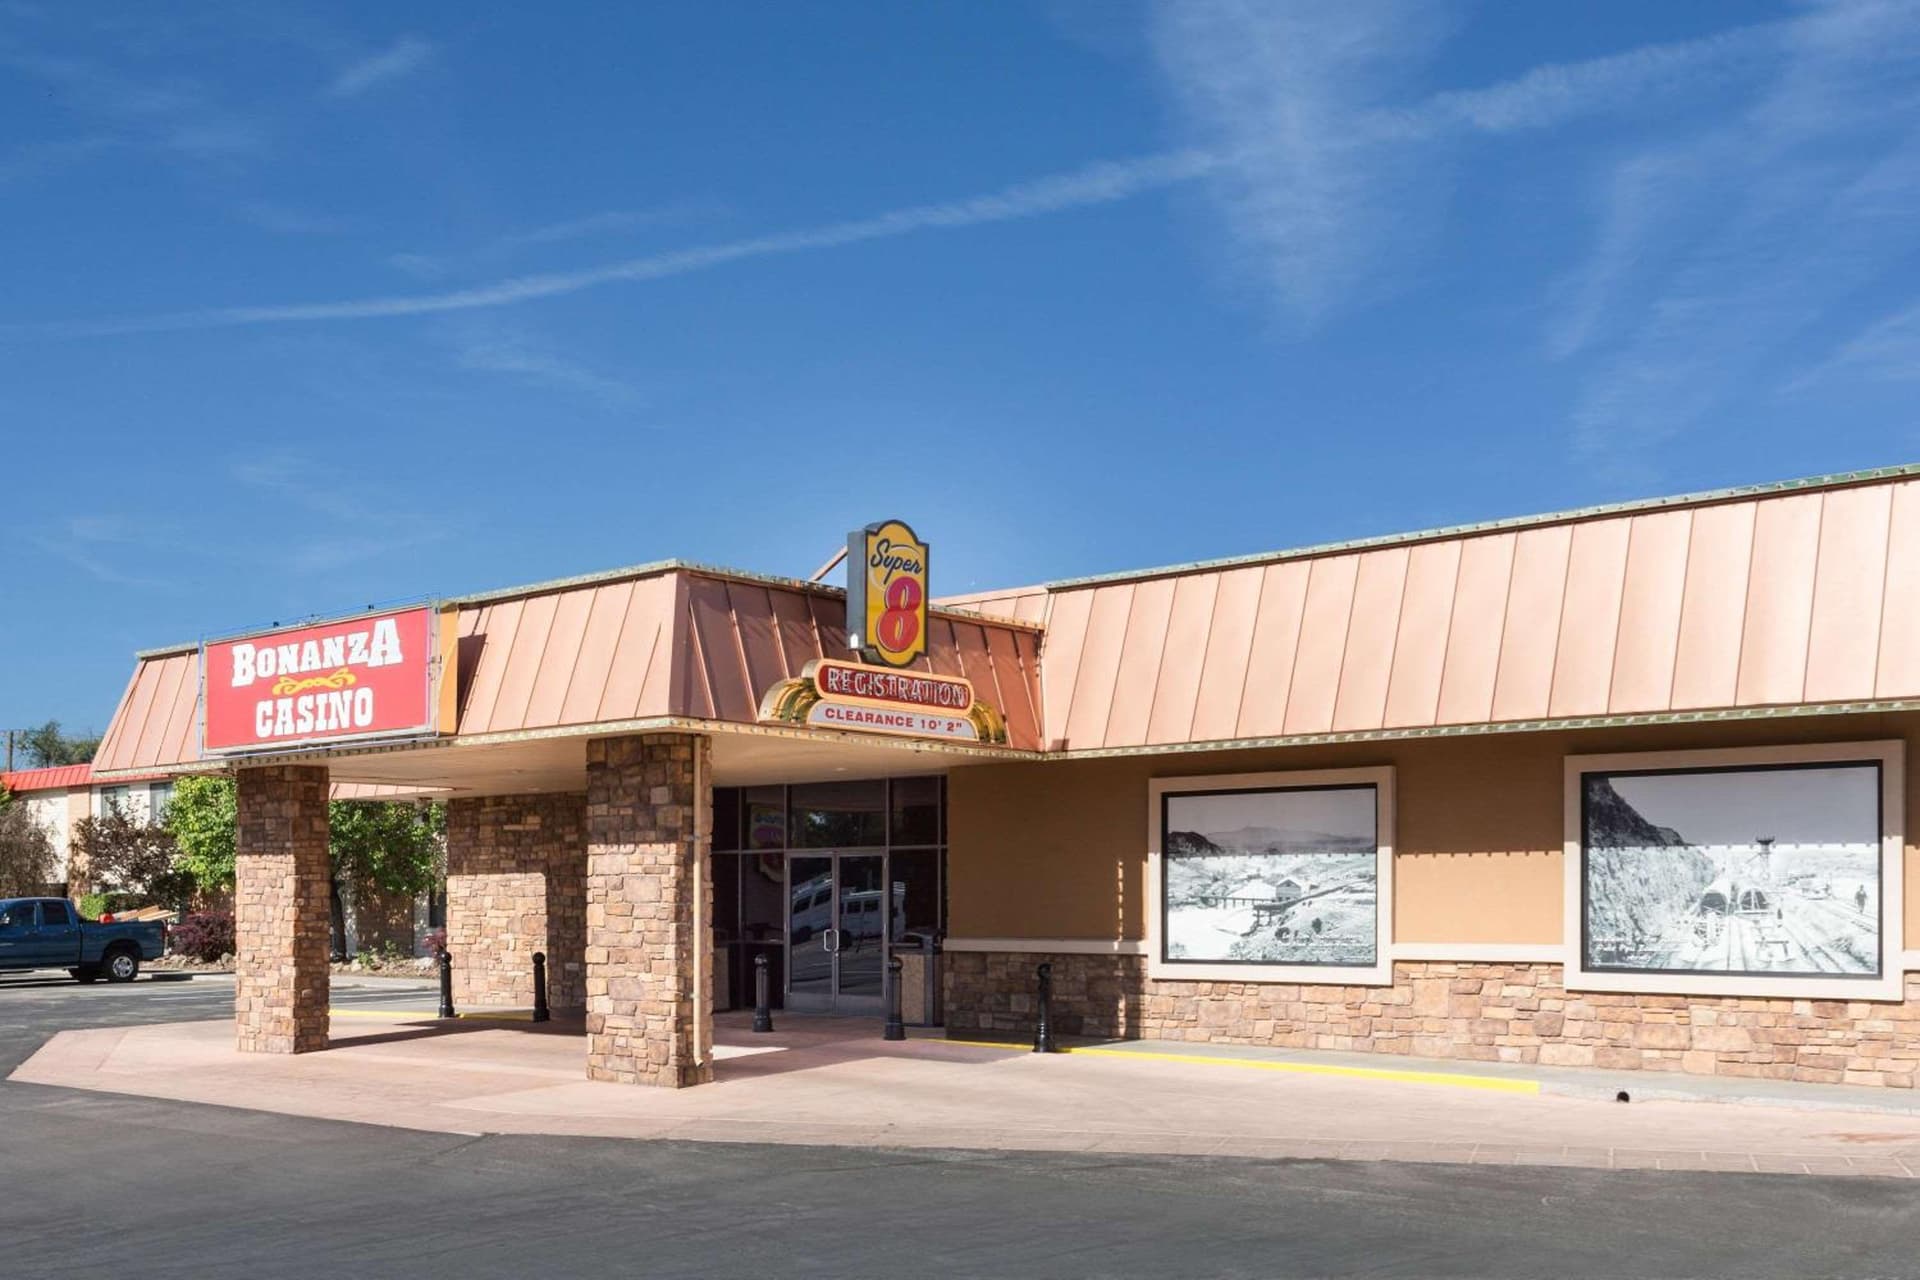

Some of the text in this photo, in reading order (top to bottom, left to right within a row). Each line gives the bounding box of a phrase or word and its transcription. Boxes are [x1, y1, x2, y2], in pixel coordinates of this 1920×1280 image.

[870, 538, 922, 585] Super
[876, 576, 922, 653] 8
[231, 618, 404, 687] BONANZA
[827, 667, 968, 708] REGISTRATION
[255, 687, 374, 738] CASINO
[824, 707, 914, 728] CLEARANCE
